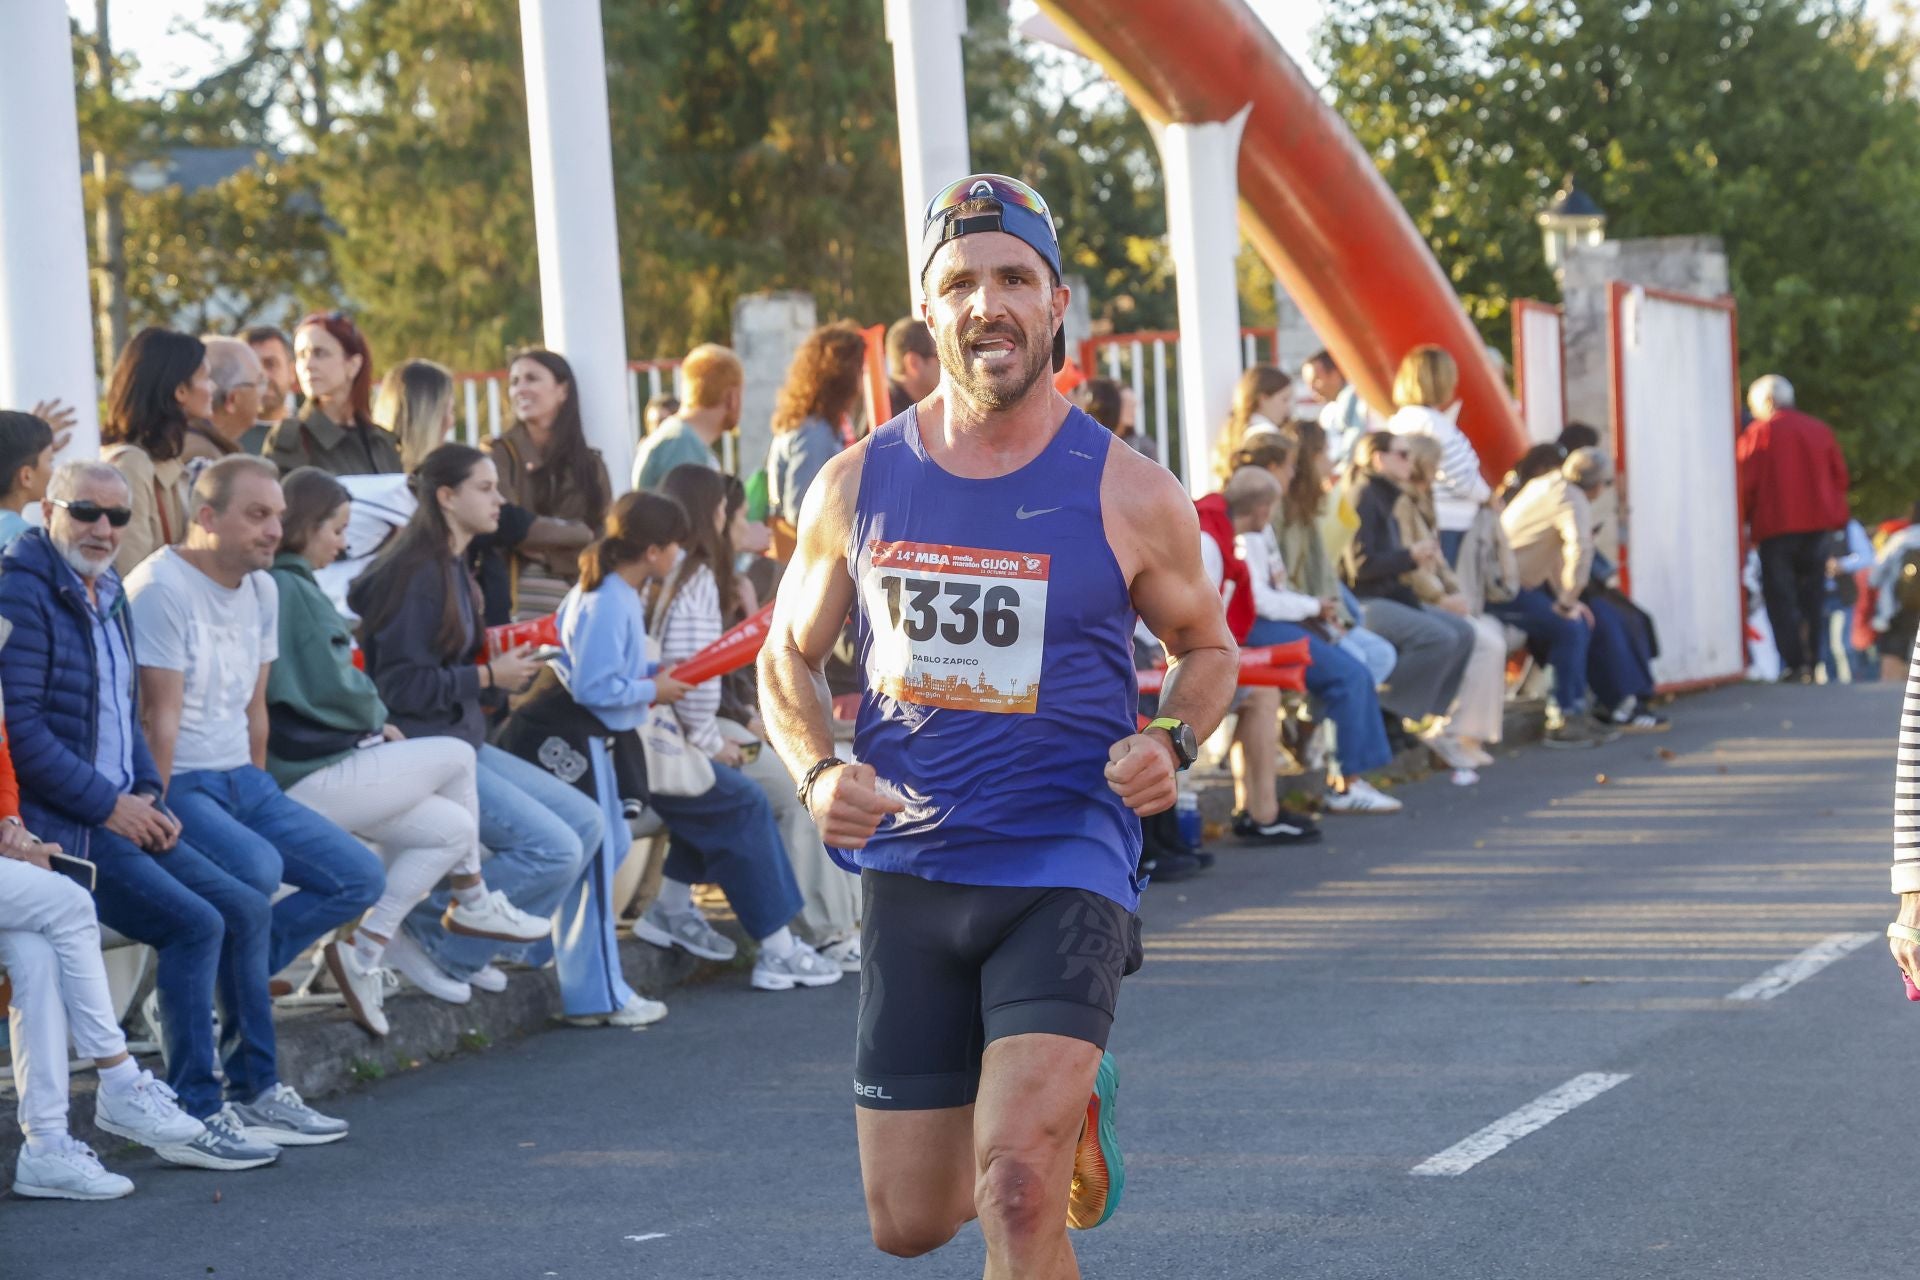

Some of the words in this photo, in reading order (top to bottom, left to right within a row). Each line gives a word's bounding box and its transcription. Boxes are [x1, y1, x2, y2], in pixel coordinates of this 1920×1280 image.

[915, 552, 950, 566] MBA
[952, 561, 980, 569] maratón
[980, 557, 1019, 571] GIJÓN
[881, 575, 1021, 648] 1336
[912, 654, 941, 664] PABLO
[942, 657, 979, 666] ZAPICO
[853, 1078, 893, 1100] BEL
